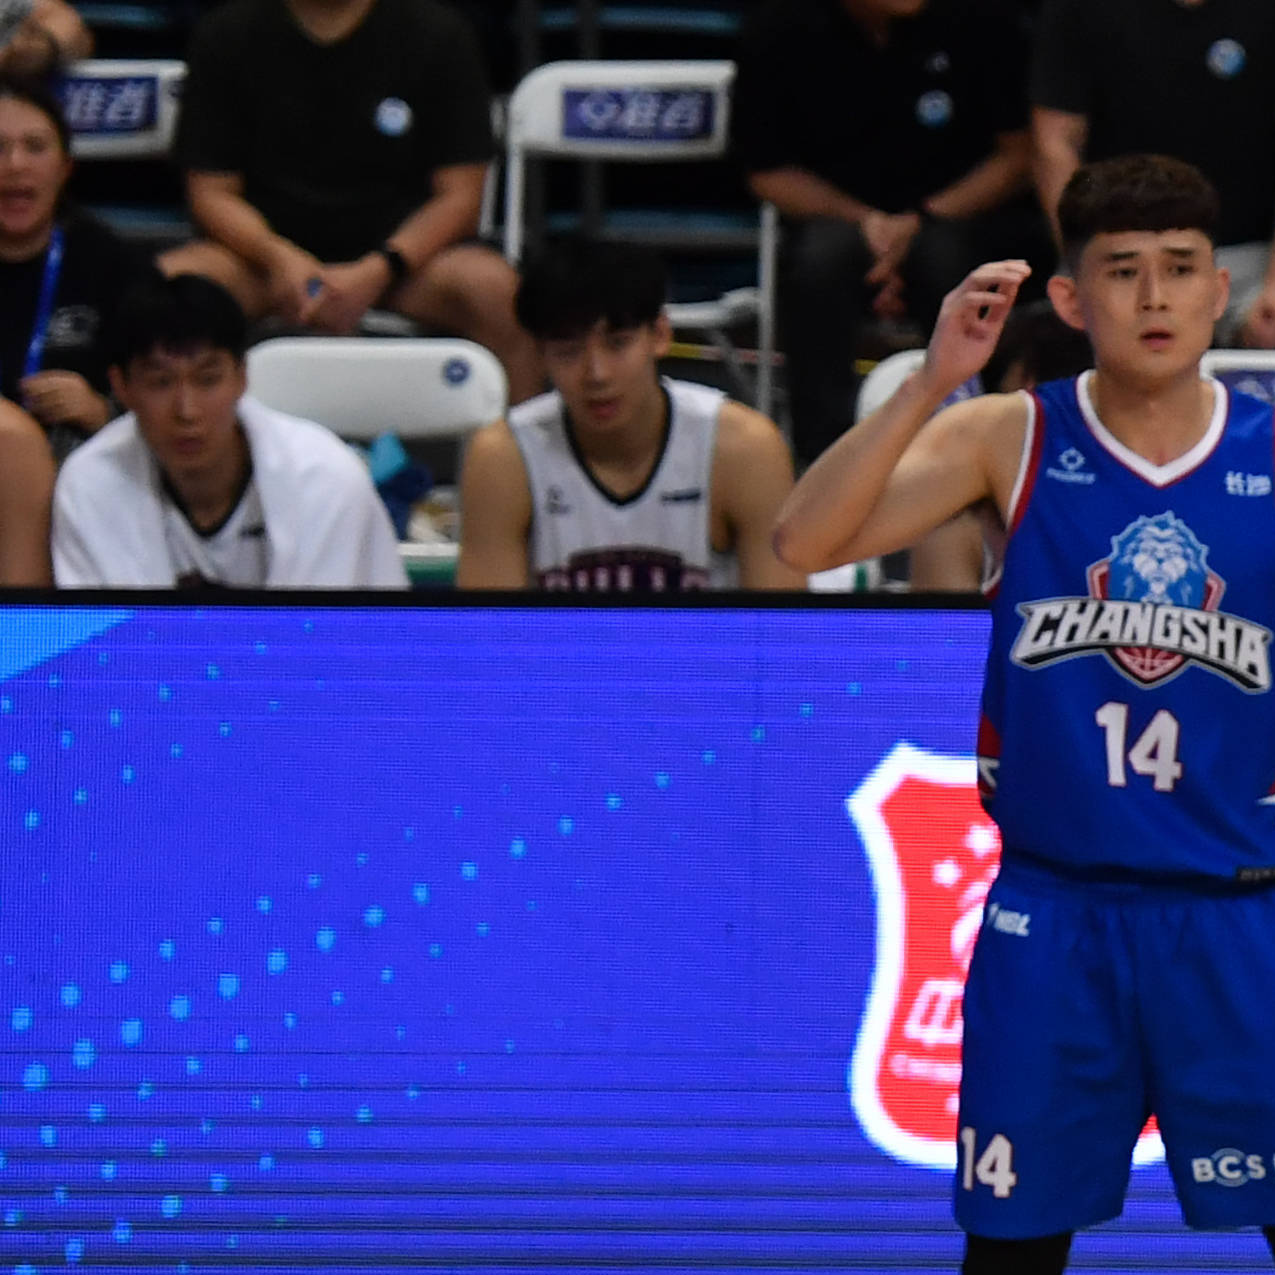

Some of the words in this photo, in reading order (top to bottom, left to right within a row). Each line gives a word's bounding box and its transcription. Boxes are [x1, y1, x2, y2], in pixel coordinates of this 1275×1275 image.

[1020, 602, 1271, 678] CHANGSHA
[1096, 701, 1182, 791] 14
[961, 1126, 1017, 1198] 14
[1192, 1152, 1266, 1183] BCS
